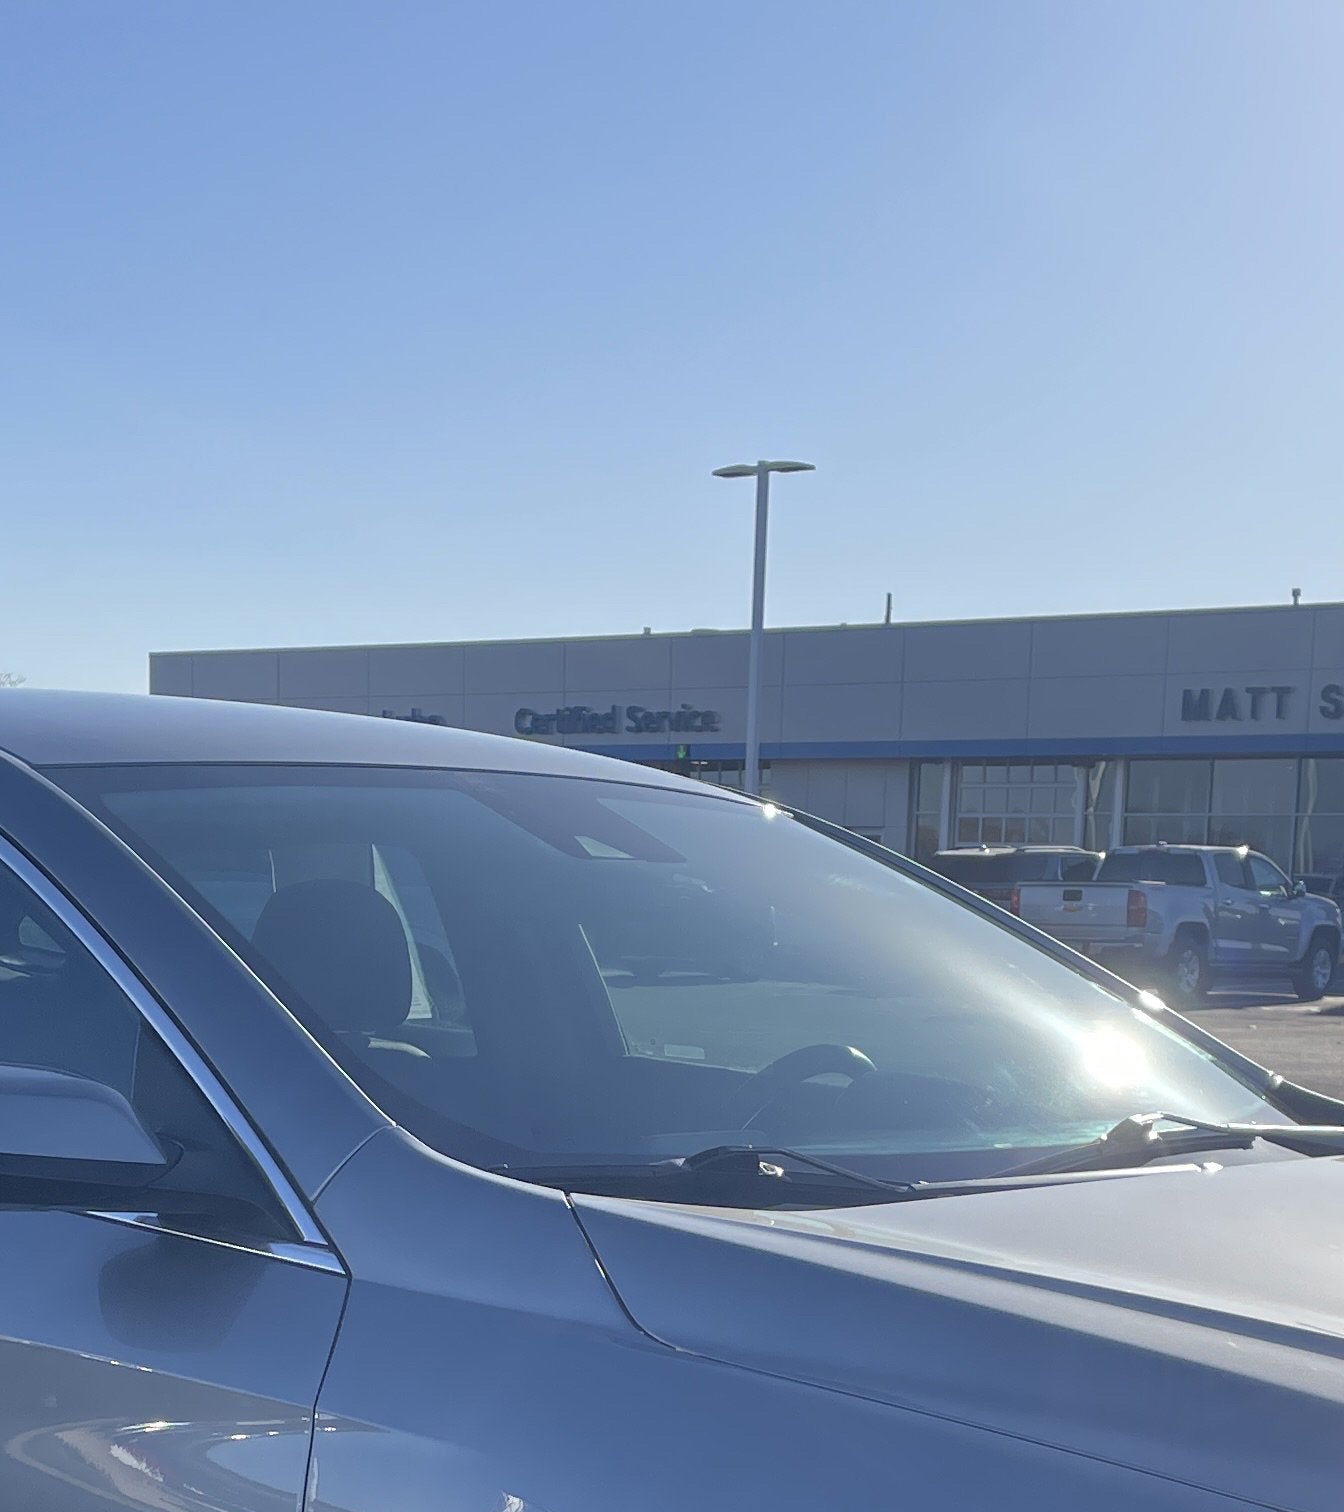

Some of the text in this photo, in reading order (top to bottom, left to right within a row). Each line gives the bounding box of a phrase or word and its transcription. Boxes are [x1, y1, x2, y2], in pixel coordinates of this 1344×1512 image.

[514, 703, 721, 735] Certified Service
[1181, 686, 1294, 722] MATT
